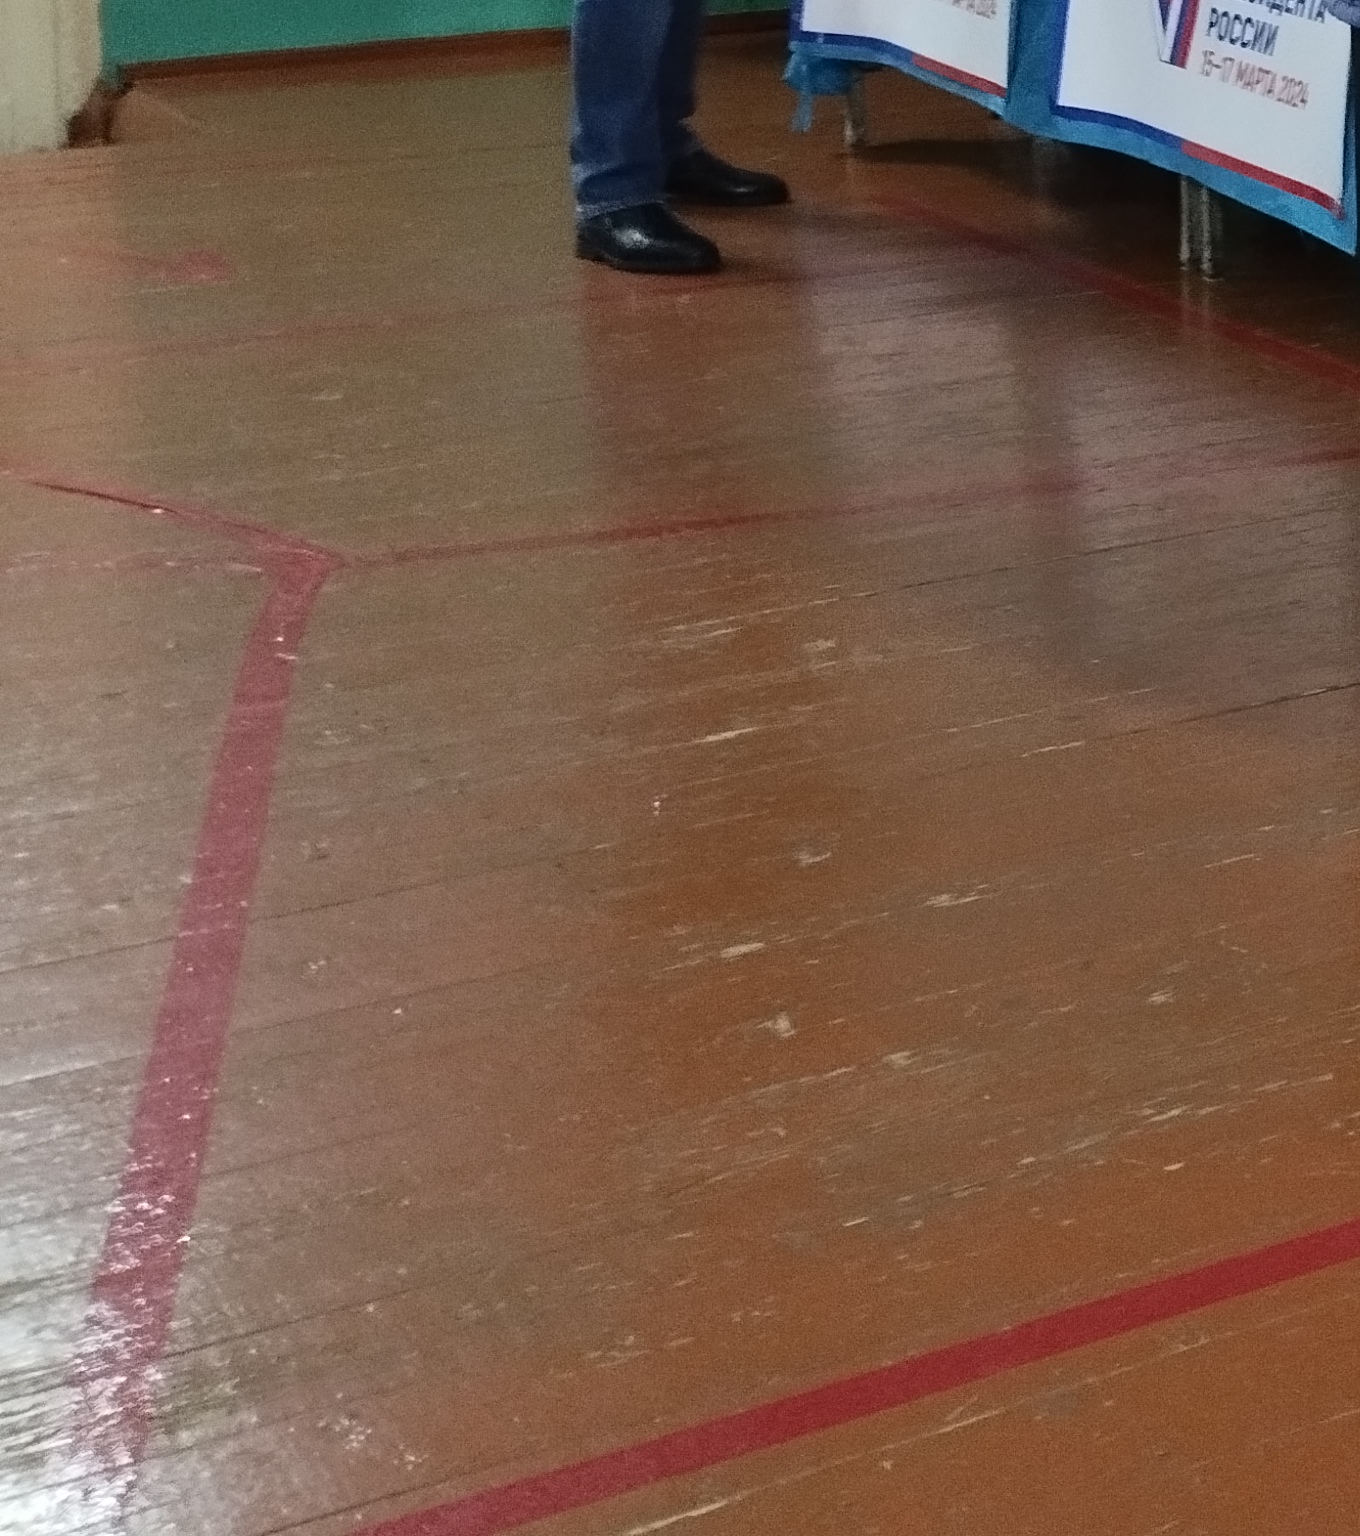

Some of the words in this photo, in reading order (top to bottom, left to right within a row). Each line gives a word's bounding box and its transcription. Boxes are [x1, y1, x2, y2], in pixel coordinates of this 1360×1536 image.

[1206, 7, 1279, 56] РОССИИ
[1235, 60, 1276, 98] МАРТА
[1276, 75, 1310, 111] 2024
